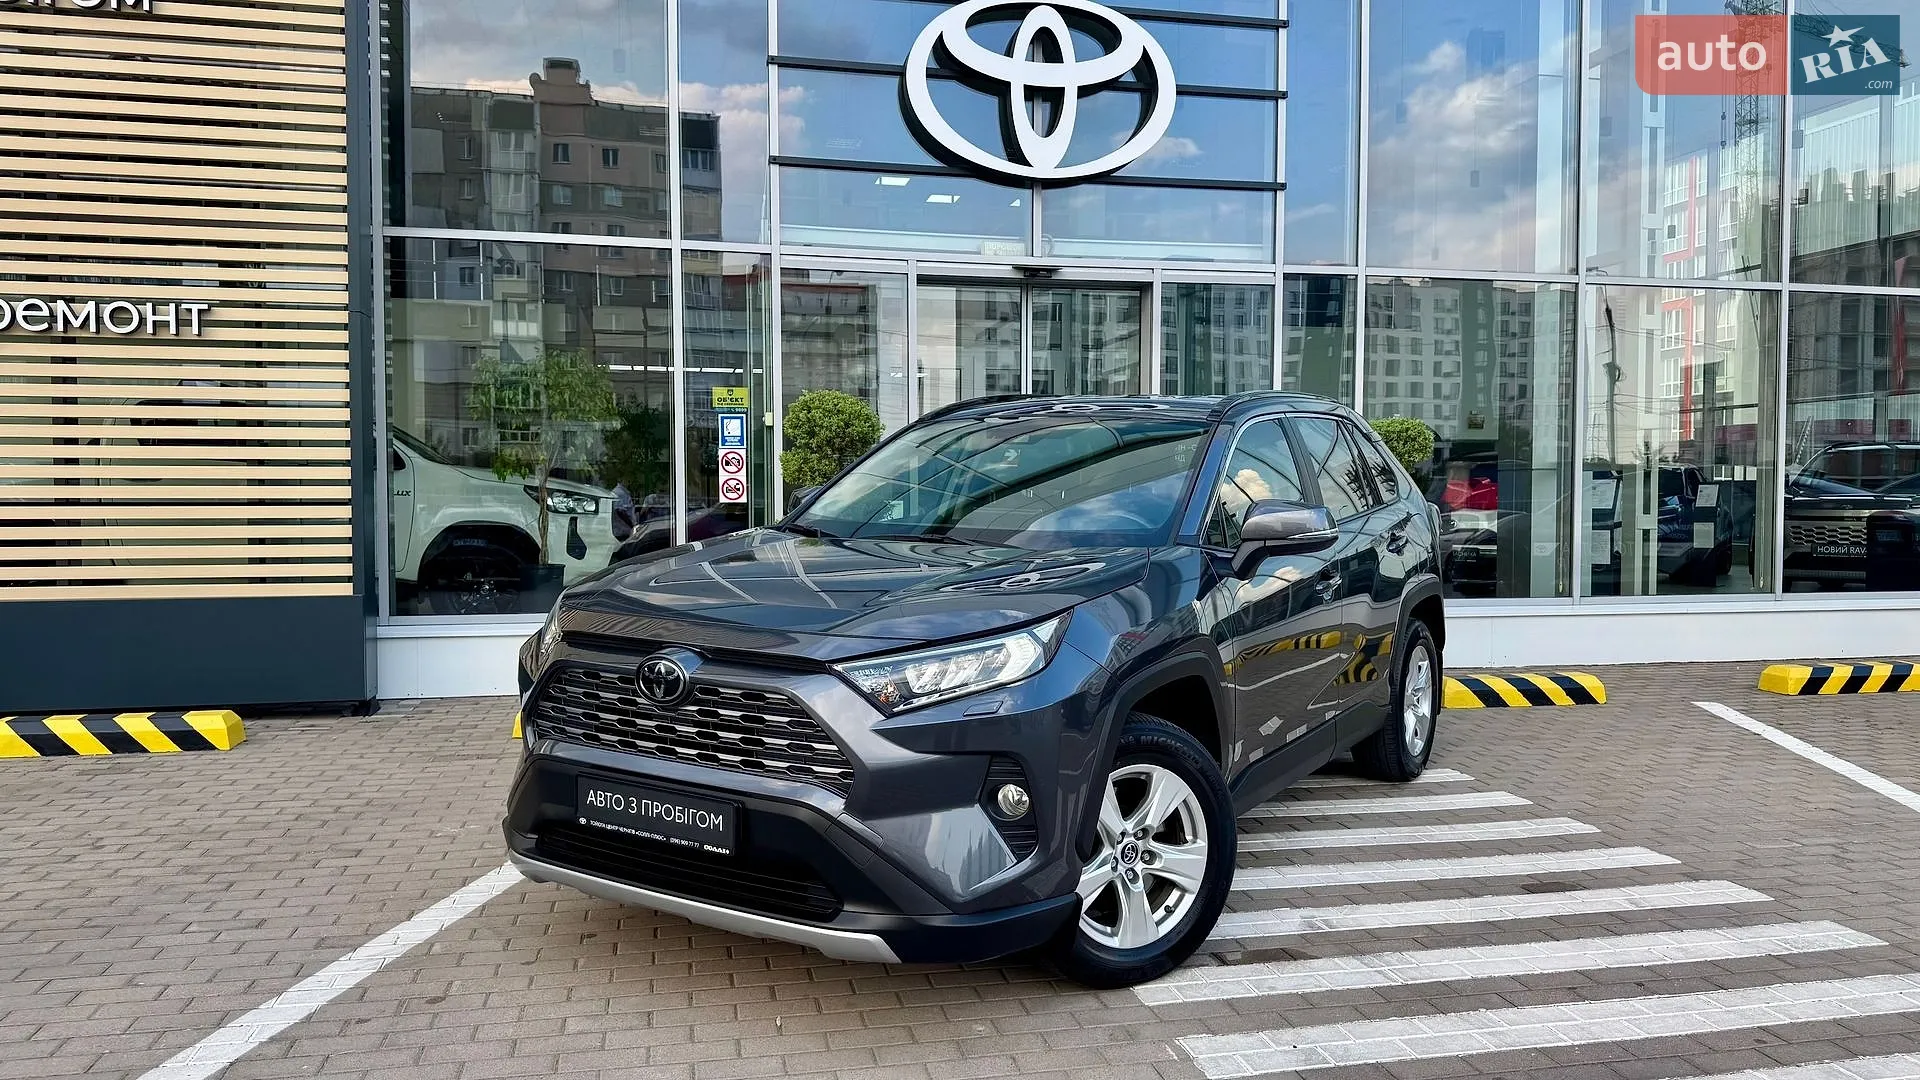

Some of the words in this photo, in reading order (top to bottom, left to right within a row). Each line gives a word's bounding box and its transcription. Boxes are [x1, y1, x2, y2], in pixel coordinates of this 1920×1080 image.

[1817, 544, 1848, 554] НОВИЙ
[1849, 546, 1867, 555] RAV
[586, 789, 625, 811] АВТО
[641, 800, 723, 832] ПРОБІГОМ
